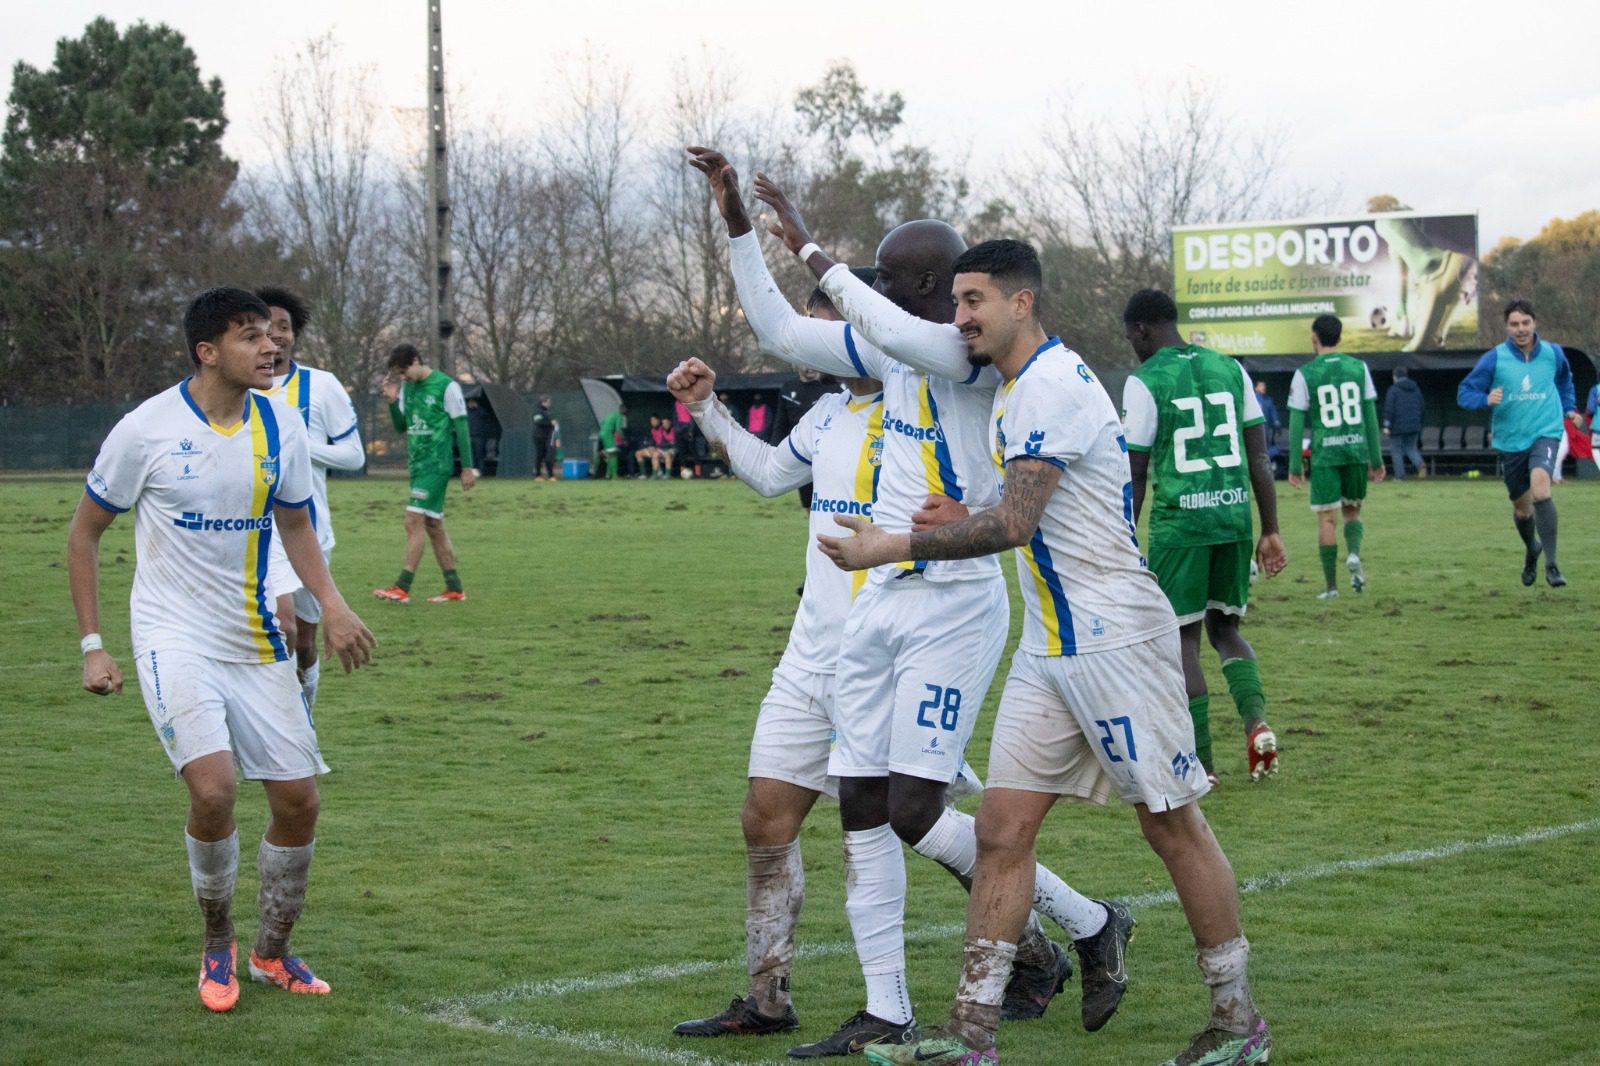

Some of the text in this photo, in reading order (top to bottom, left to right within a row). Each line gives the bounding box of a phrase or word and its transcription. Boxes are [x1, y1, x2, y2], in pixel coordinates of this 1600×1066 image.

[1184, 225, 1379, 272] DESPORTO
[1187, 271, 1371, 295] fonte de saúde e bem estar
[1189, 307, 1208, 319] COM
[1317, 381, 1362, 428] 88
[1171, 391, 1242, 473] 23
[817, 498, 872, 516] reconc
[916, 683, 962, 731] 28
[1094, 715, 1138, 762] 27
